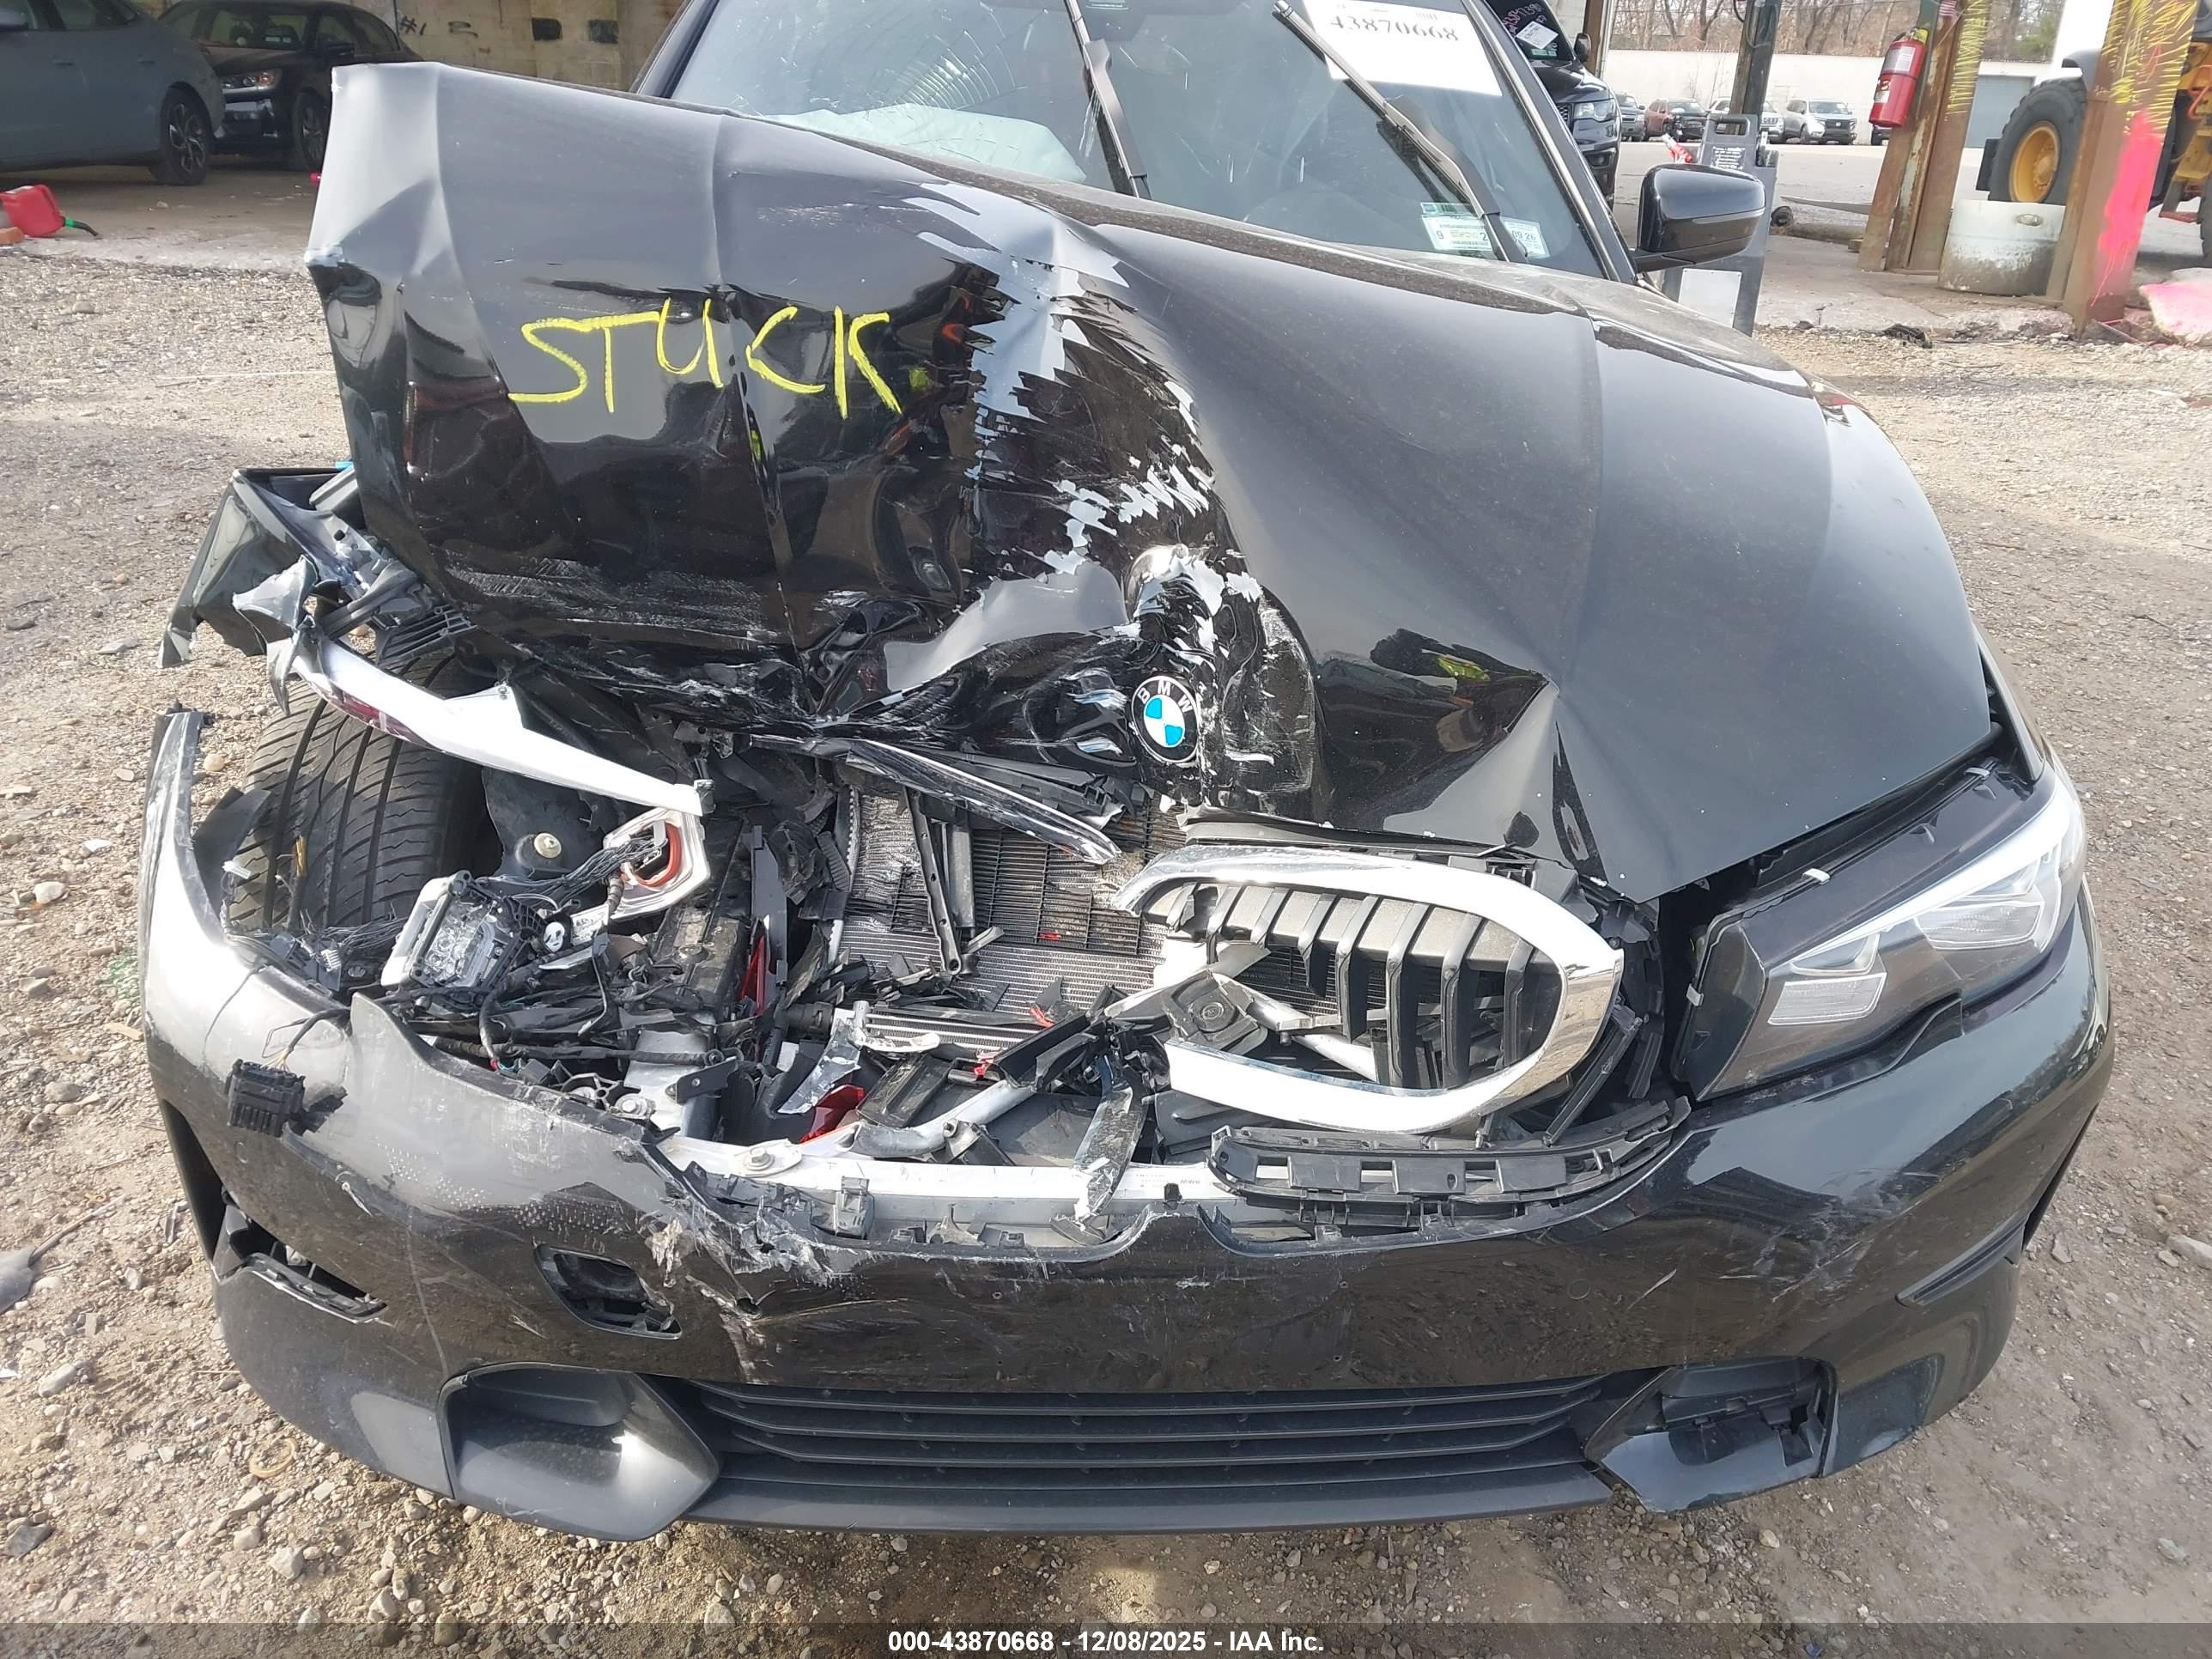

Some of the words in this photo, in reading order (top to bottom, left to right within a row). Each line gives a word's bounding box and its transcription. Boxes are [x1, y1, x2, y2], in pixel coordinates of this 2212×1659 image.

[1330, 15, 1459, 41] 43870668
[507, 295, 904, 420] STUCK
[1137, 679, 1194, 714] BMW
